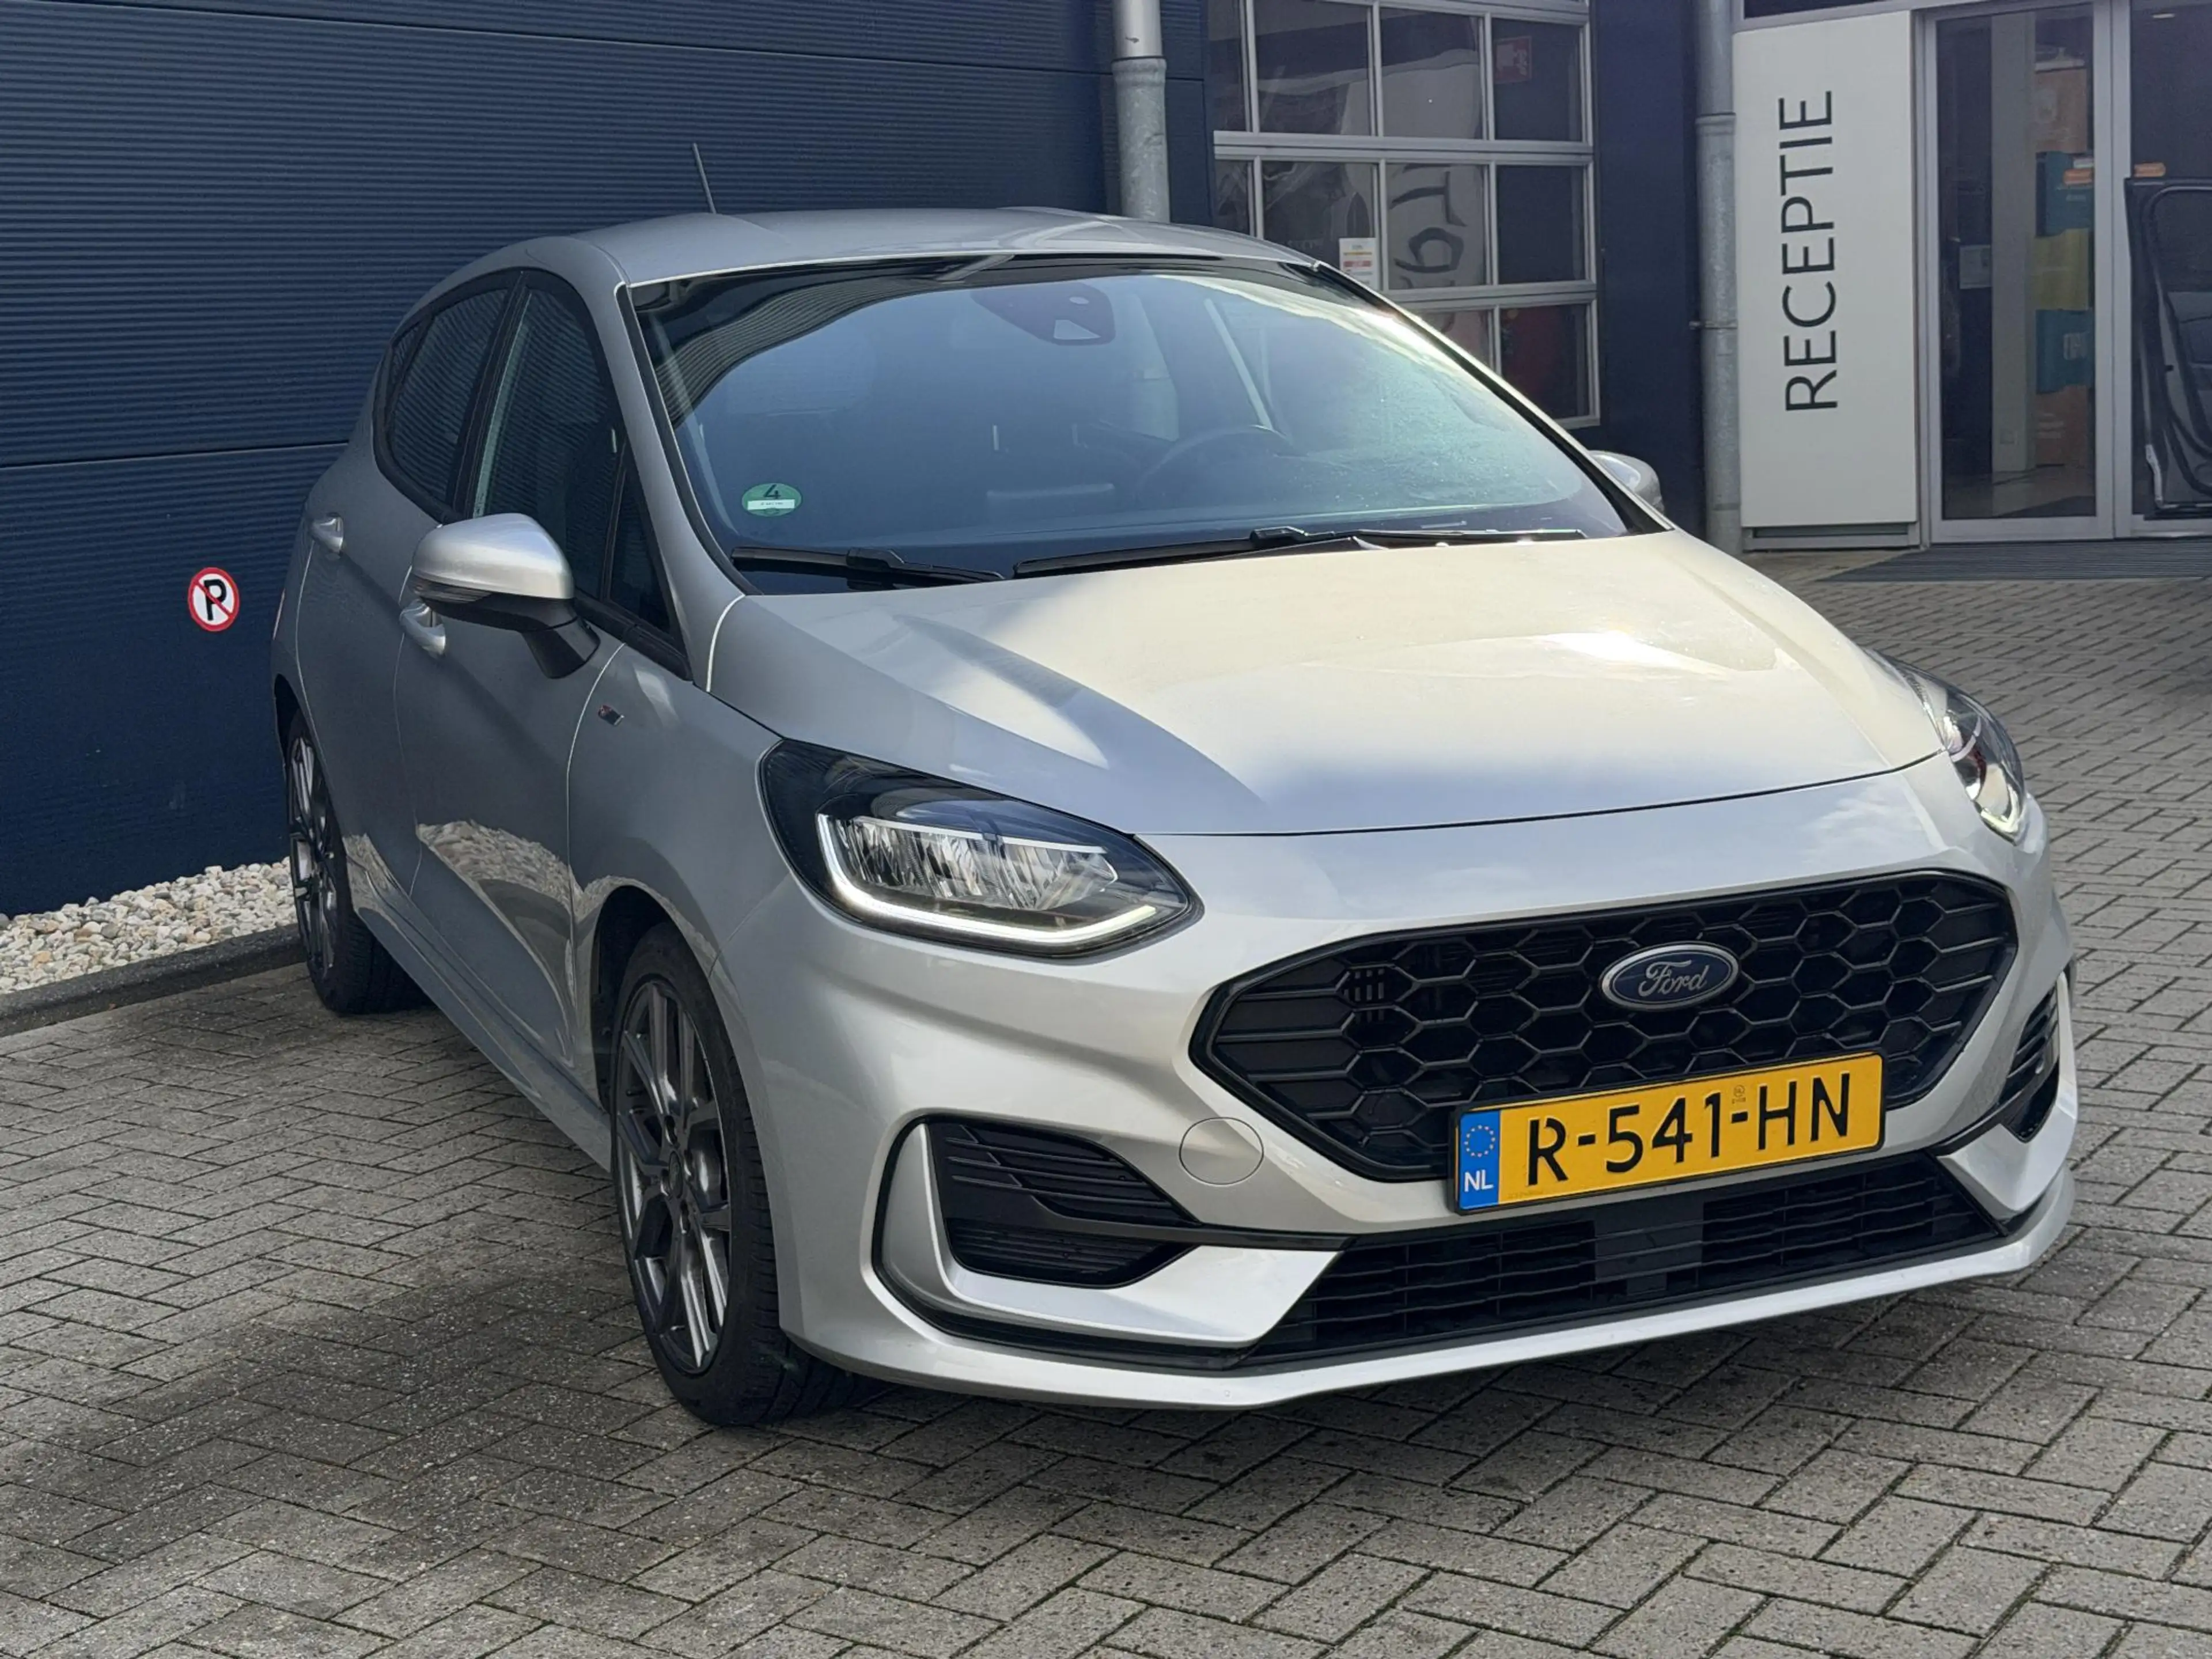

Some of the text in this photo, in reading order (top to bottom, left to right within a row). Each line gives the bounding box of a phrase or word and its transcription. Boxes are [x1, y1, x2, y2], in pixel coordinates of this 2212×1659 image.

[1778, 91, 1838, 411] RECEPTIE
[763, 484, 781, 499] 4
[203, 579, 228, 621] P
[1638, 959, 1709, 997] Ford
[1528, 1072, 1850, 1186] R-541-HN
[1464, 1169, 1494, 1192] NL
